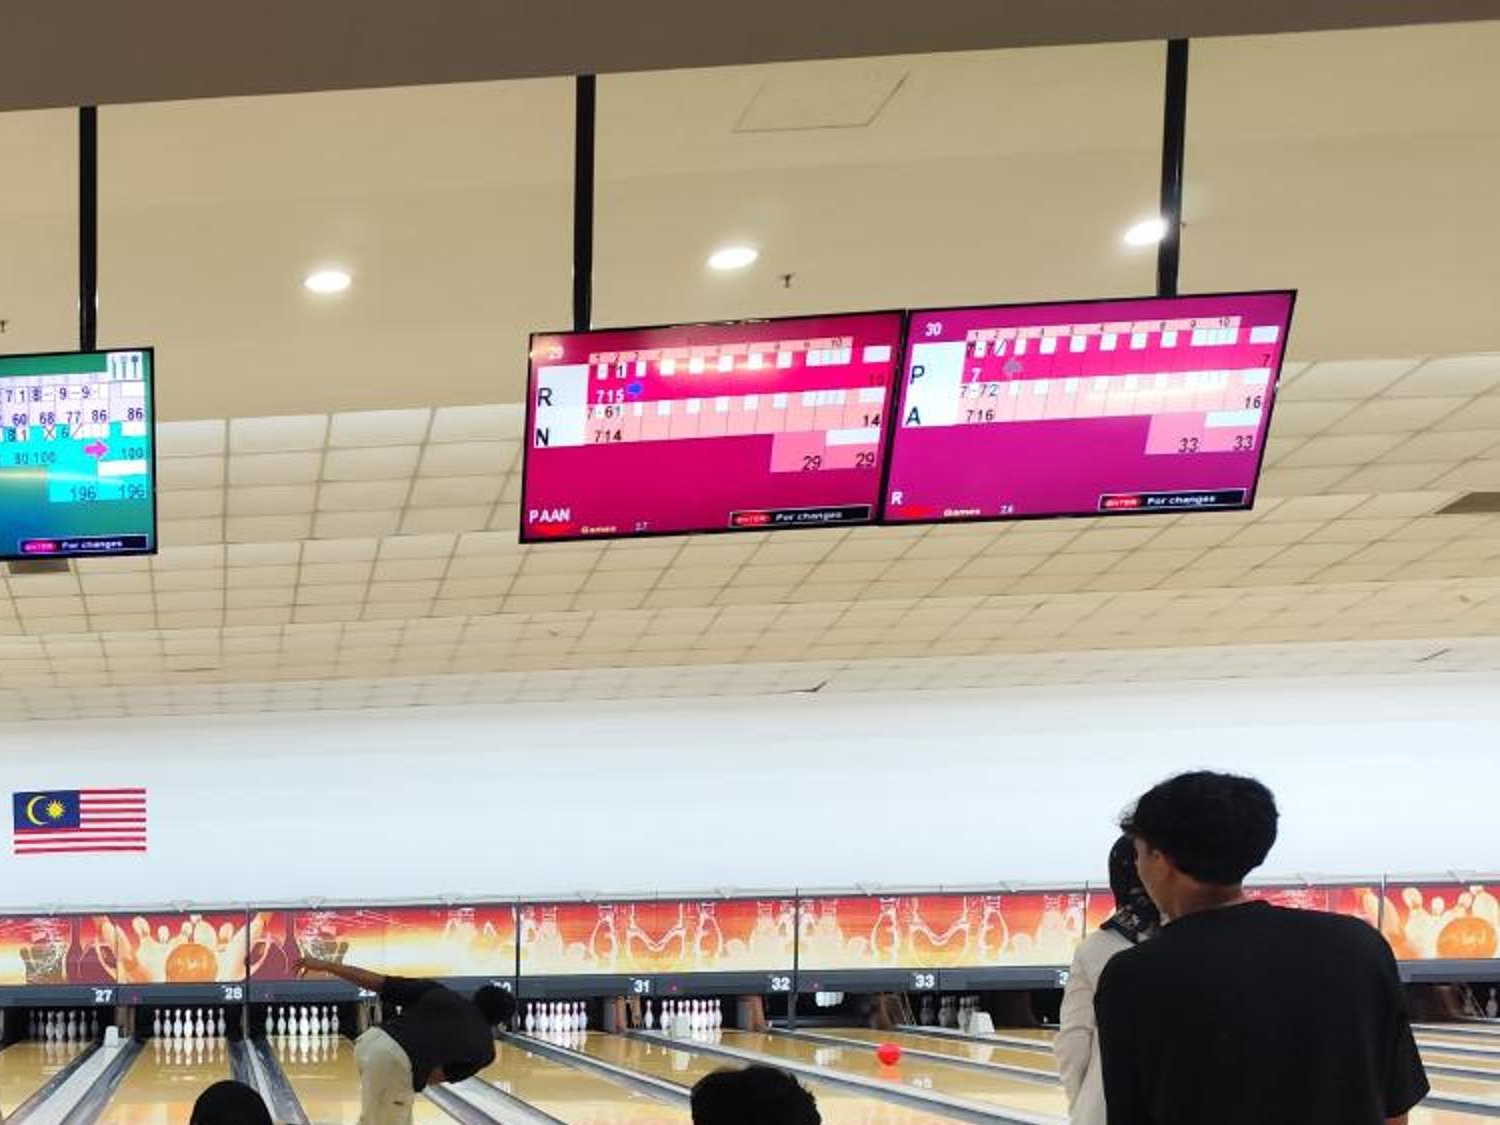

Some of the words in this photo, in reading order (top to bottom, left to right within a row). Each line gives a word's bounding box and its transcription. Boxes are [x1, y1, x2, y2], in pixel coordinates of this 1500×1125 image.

[925, 321, 943, 337] 30
[910, 365, 925, 384] P
[538, 387, 553, 407] R
[1244, 395, 1262, 409] 16
[91, 409, 108, 423] 86
[127, 407, 143, 421] 86
[863, 413, 881, 427] 14
[906, 406, 921, 425] A
[536, 428, 549, 446] N
[1178, 437, 1200, 453] 33
[1233, 435, 1254, 451] 33
[803, 456, 822, 471] 29
[856, 452, 875, 468] 29
[891, 491, 903, 506] R
[529, 508, 571, 523] PAAN
[634, 979, 650, 992] 31
[771, 977, 790, 991] 32
[915, 974, 934, 988] 33
[95, 989, 112, 1002] 27
[225, 987, 243, 1000] 28
